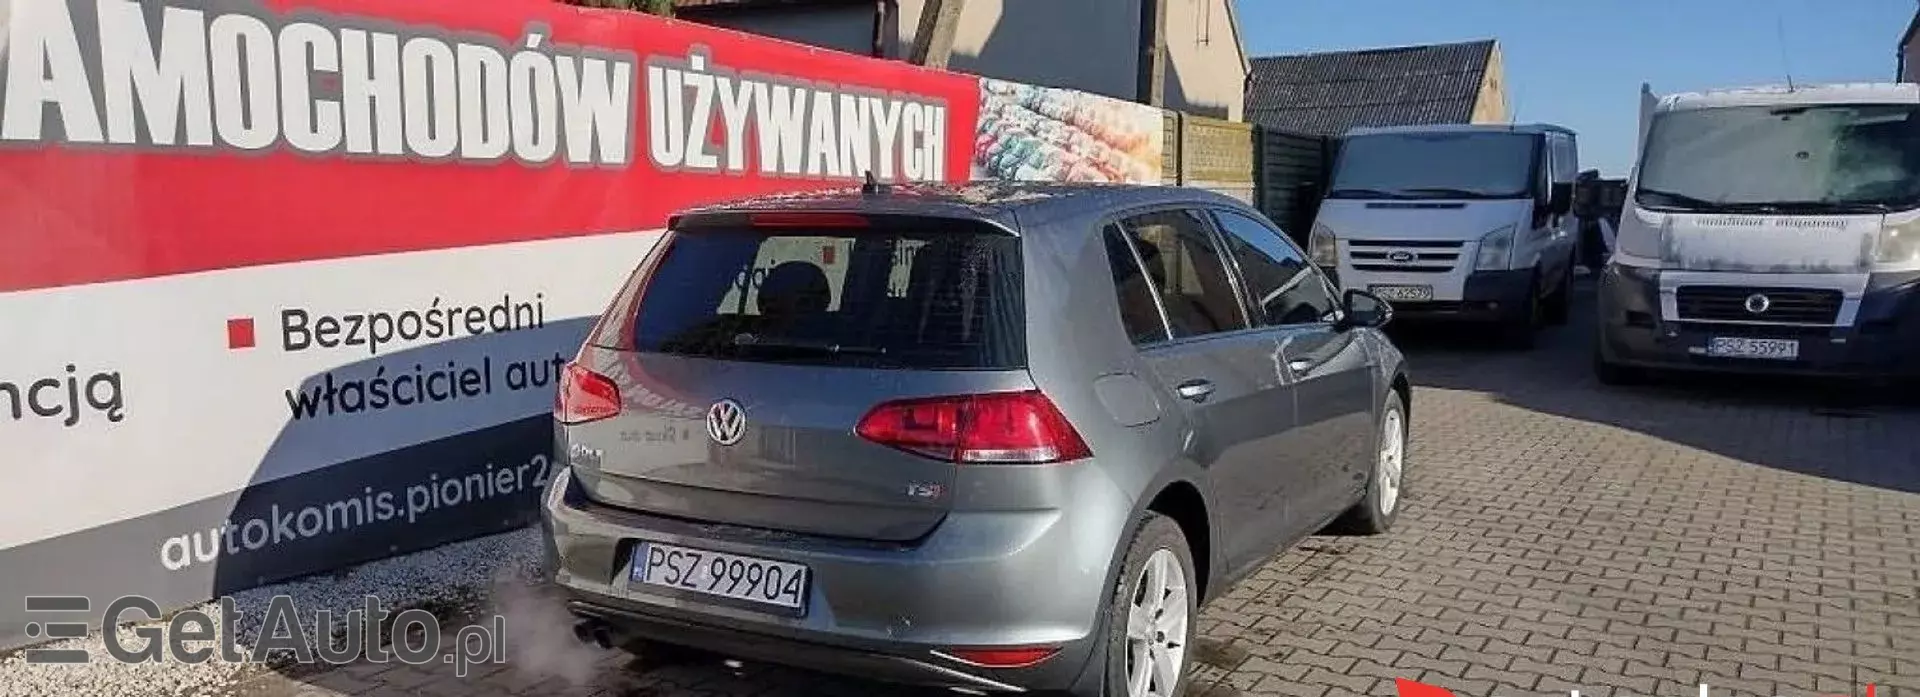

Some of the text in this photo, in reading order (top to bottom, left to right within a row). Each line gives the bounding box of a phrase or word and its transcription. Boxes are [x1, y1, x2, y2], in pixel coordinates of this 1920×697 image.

[1, 0, 946, 182] AMOCHODÓW UŻYWANYCH
[281, 293, 544, 354] Bezpośredni
[285, 356, 492, 420] właściciel
[646, 546, 801, 604] PSZ 99904
